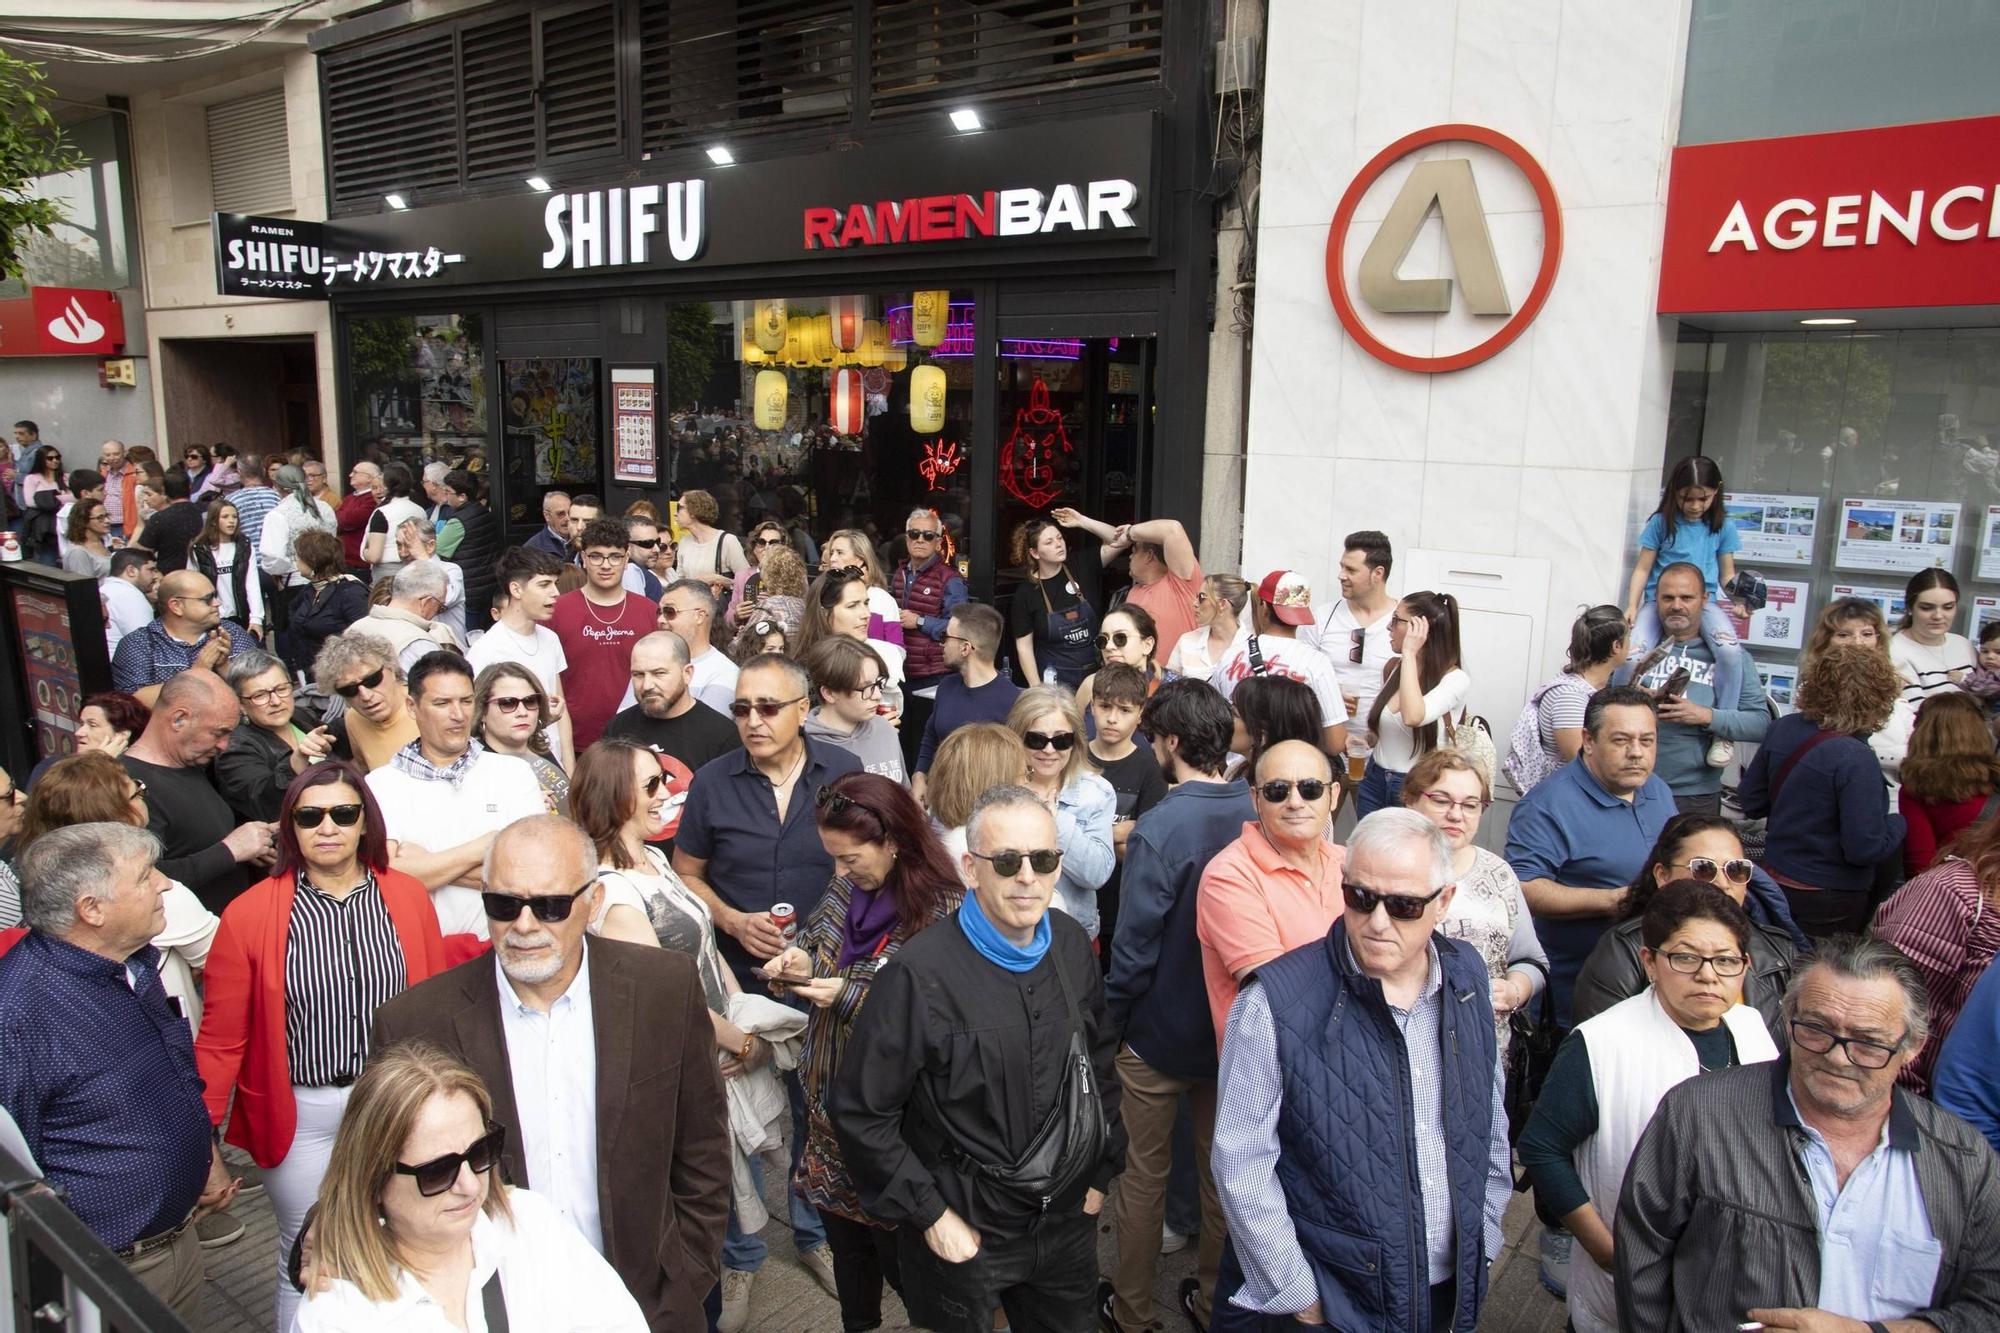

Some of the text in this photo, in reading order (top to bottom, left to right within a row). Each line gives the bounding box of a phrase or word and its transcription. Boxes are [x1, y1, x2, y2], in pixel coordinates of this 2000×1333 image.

[251, 225, 294, 236] RAMEN
[543, 179, 705, 269] SHIFU
[228, 239, 320, 275] SHIFU
[582, 625, 635, 641] Pepe Jeans
[1064, 629, 1089, 641] SHIFU
